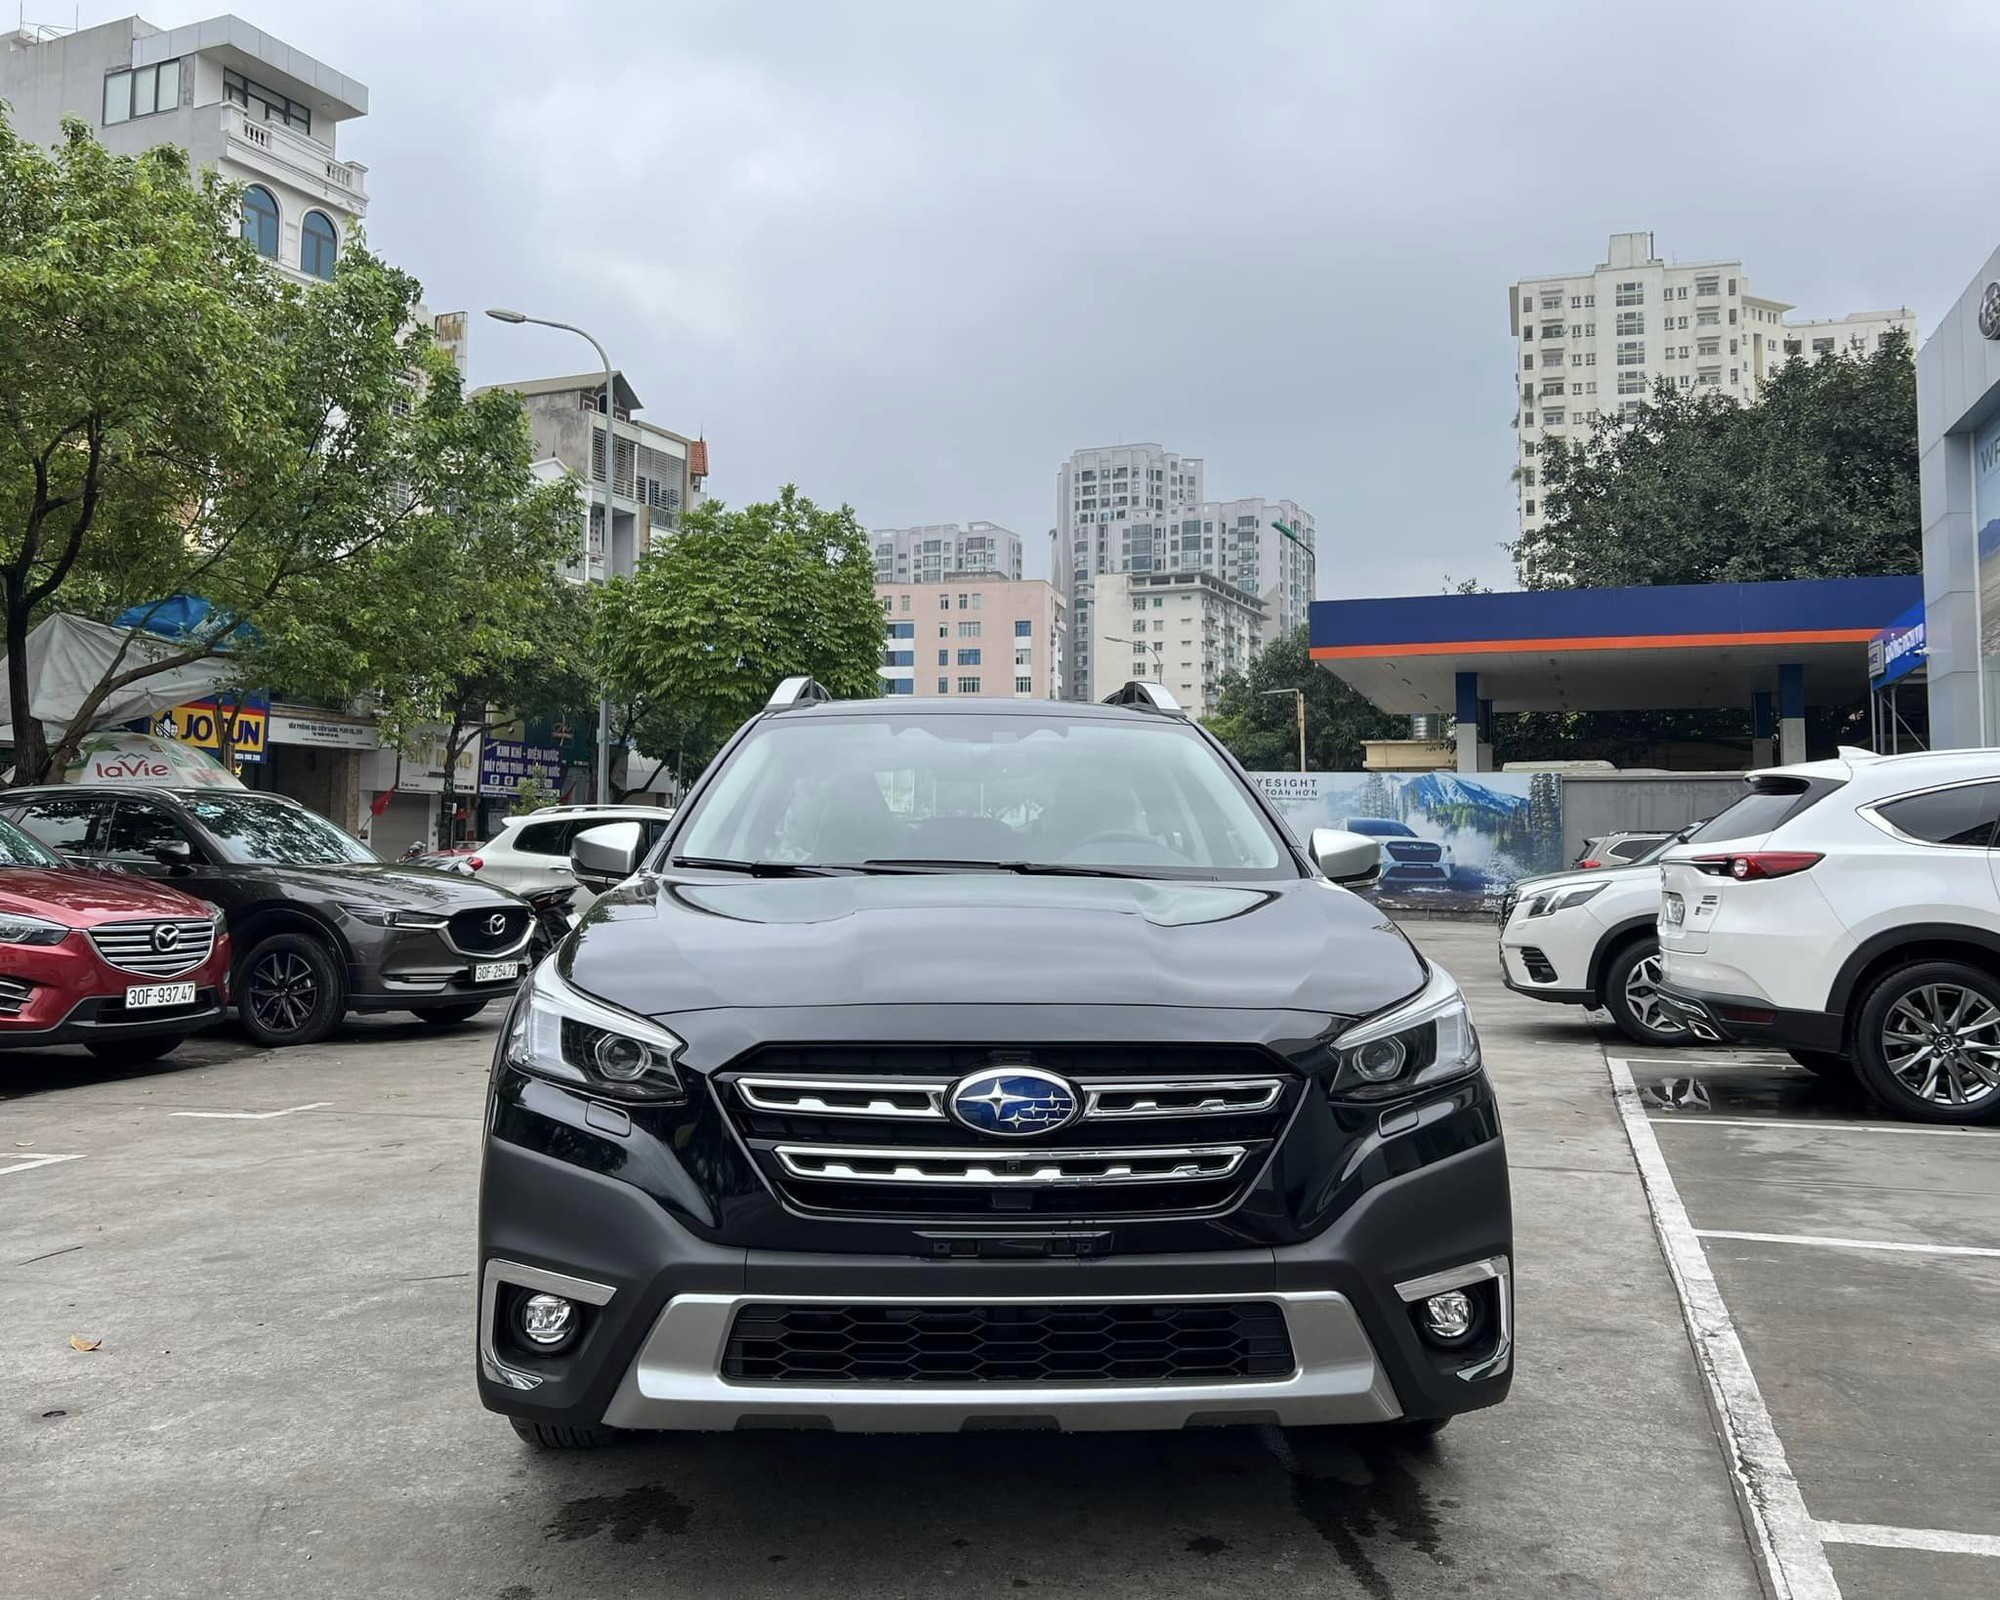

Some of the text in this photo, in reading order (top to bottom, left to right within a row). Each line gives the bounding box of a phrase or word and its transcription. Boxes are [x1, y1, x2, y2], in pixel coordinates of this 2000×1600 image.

[96, 759, 168, 778] laVie
[1295, 788, 1318, 797] HƠN
[129, 984, 194, 1006] 30F-937.47
